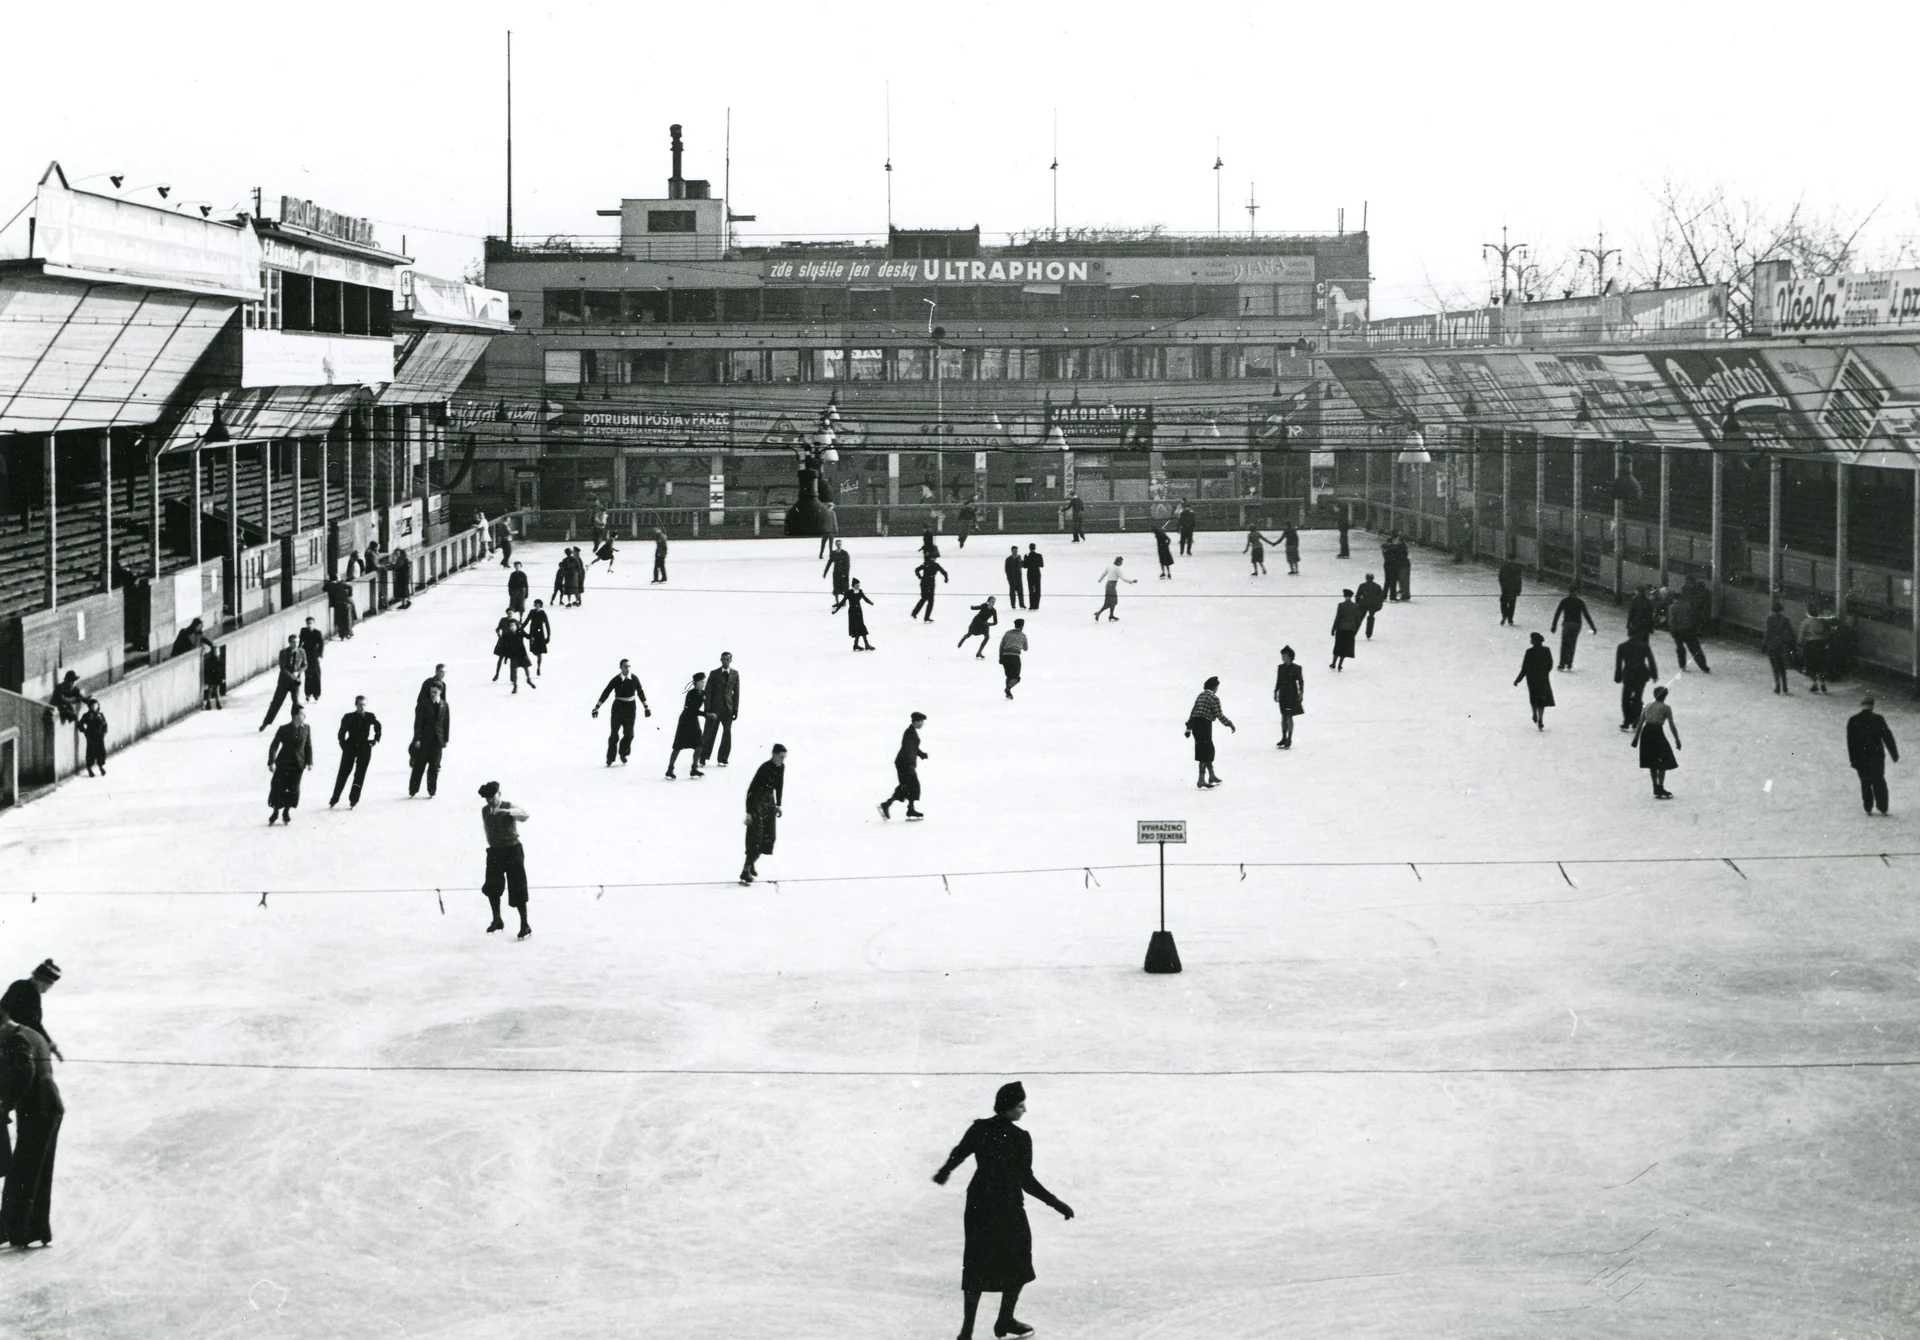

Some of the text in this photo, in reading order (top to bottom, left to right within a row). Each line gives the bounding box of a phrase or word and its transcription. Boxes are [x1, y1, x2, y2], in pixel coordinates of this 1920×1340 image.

[770, 261, 793, 277] zde
[847, 262, 870, 281] jen
[878, 261, 918, 281] desky
